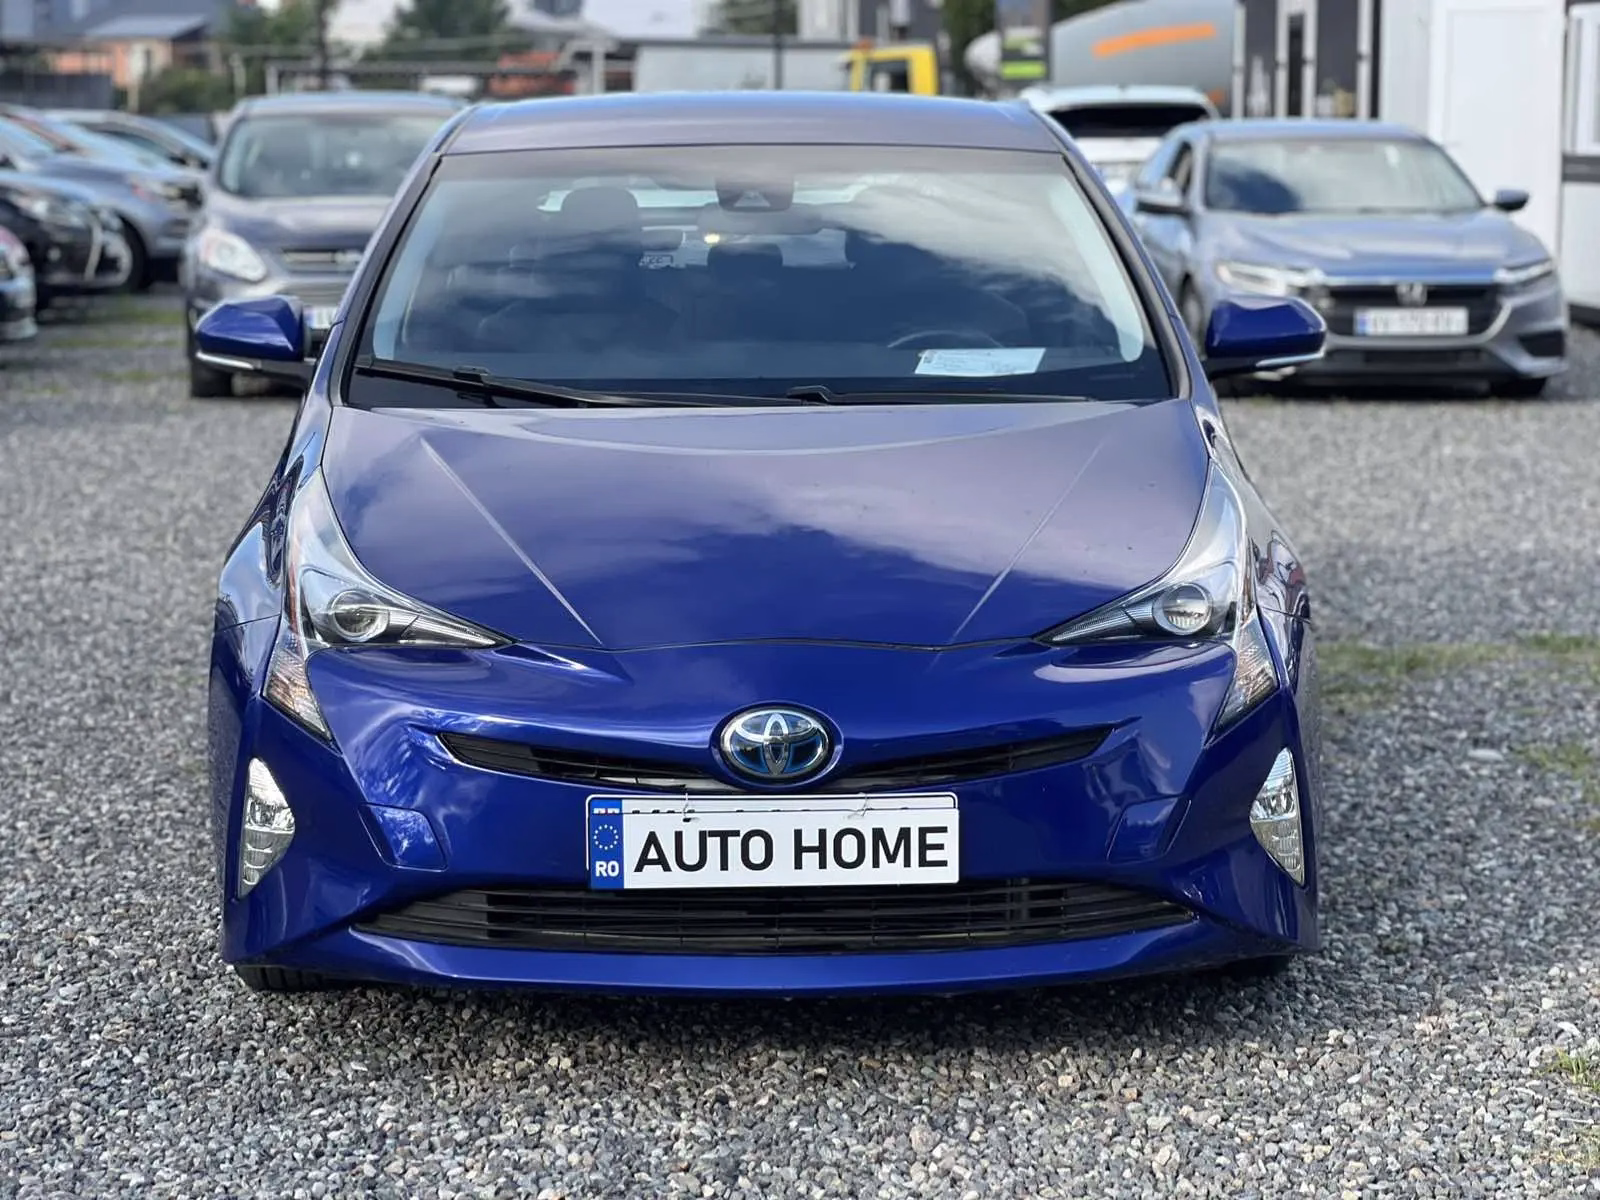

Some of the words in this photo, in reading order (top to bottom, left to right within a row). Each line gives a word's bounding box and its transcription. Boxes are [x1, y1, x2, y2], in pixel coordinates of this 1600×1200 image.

[634, 829, 774, 873] AUTO
[794, 826, 949, 870] HOME
[595, 860, 619, 877] RO
